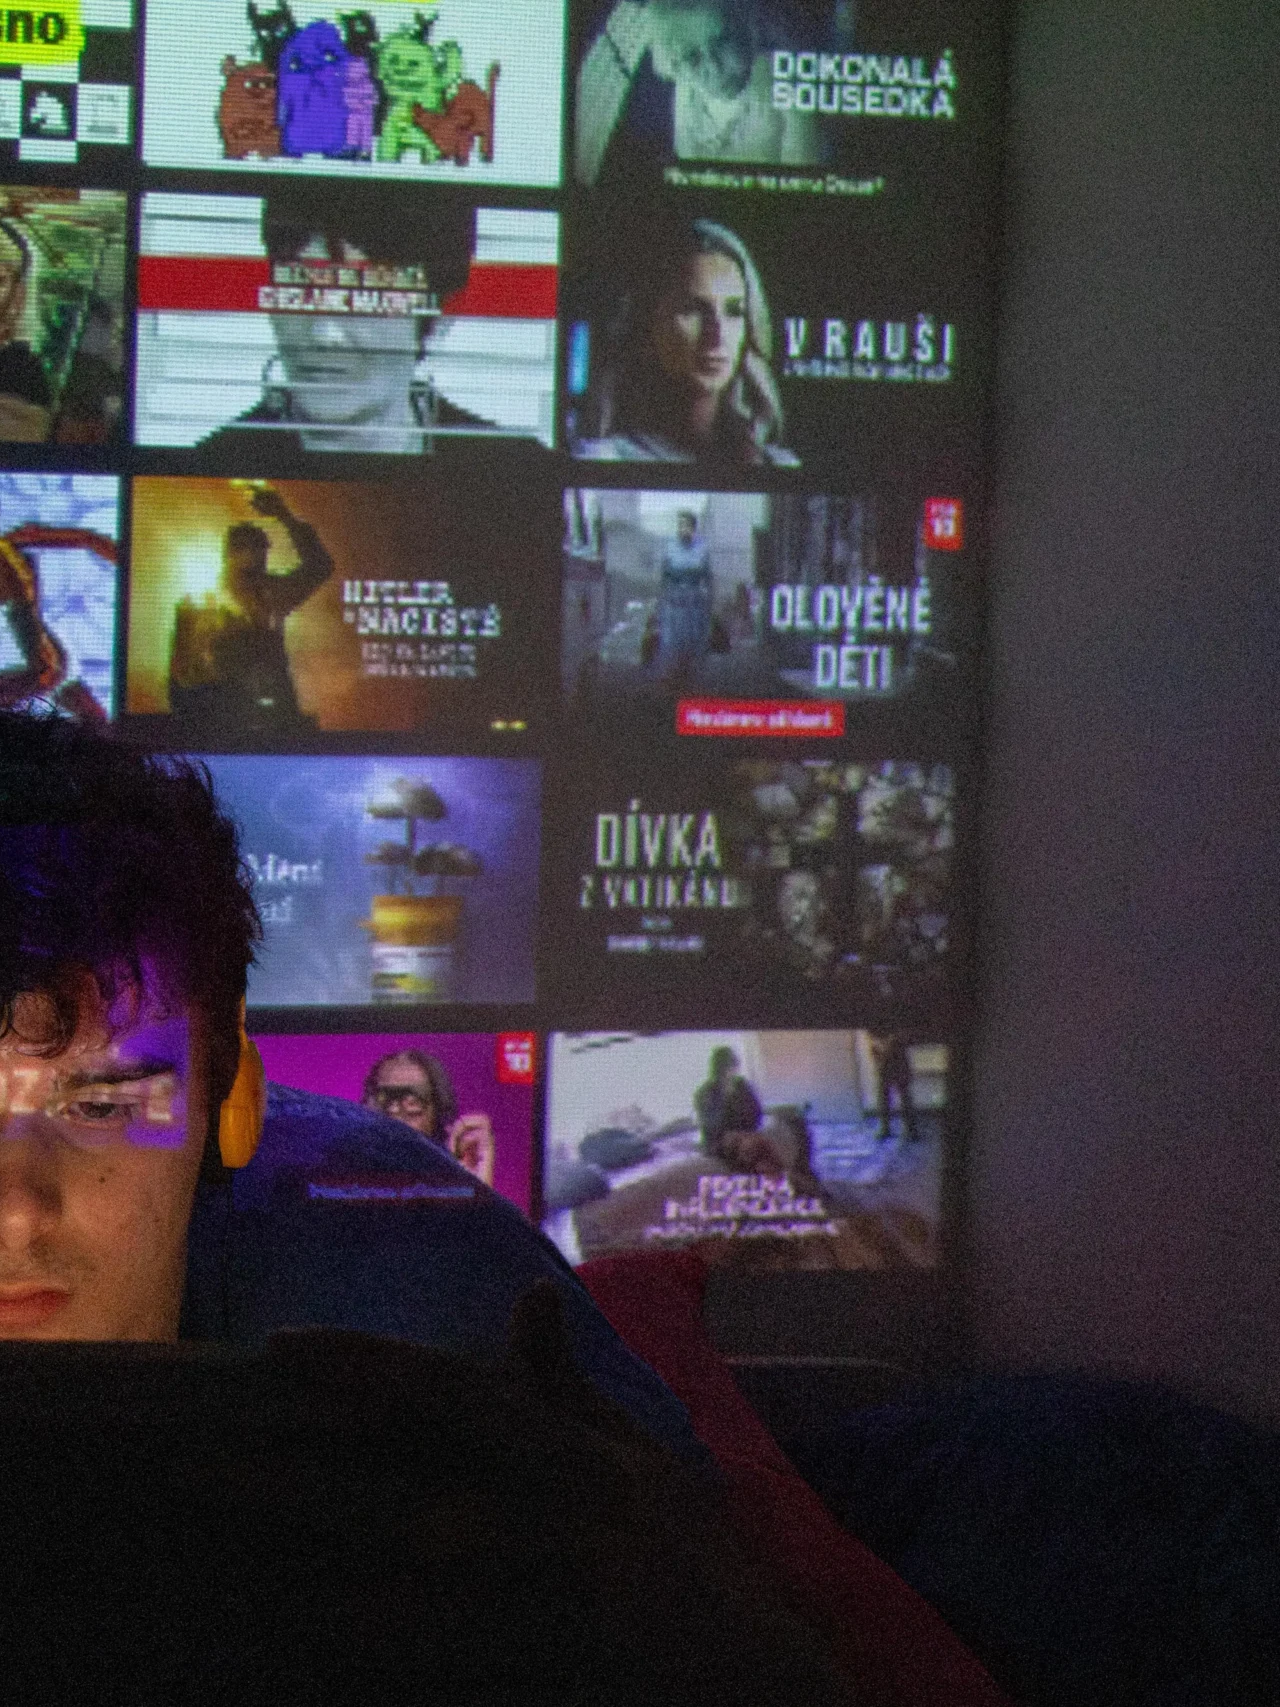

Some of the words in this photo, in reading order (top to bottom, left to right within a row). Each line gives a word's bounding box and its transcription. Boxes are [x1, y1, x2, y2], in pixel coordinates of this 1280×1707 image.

[773, 49, 957, 89] DOKONALÁ
[773, 82, 956, 119] SOUSEDKA
[596, 799, 720, 868] DÍVKA
